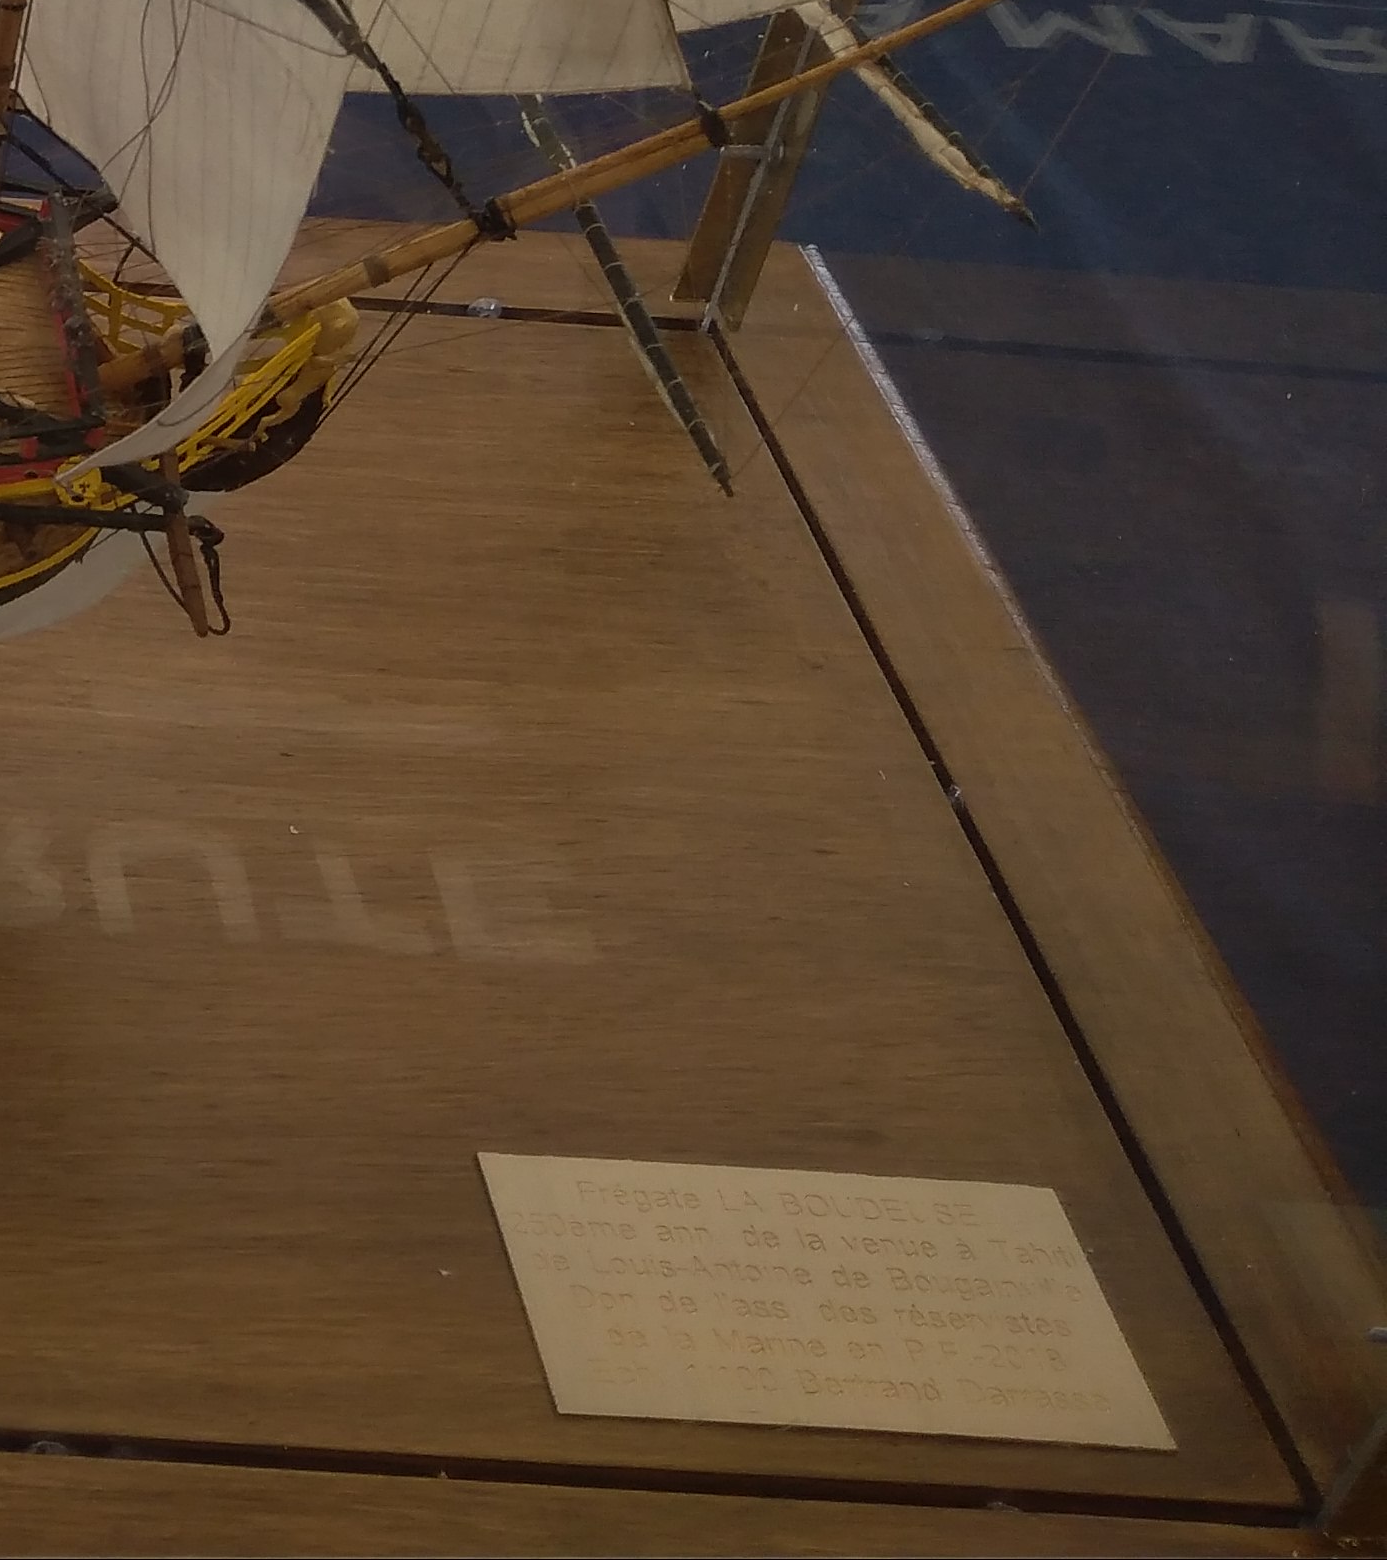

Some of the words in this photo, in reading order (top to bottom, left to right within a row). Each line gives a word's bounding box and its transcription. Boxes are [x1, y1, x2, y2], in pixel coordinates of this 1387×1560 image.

[576, 1179, 701, 1213] Frégate
[717, 1189, 763, 1213] LA
[742, 1224, 779, 1248] de
[797, 1228, 826, 1252] la
[956, 1237, 976, 1261] à
[831, 1265, 871, 1288] de
[659, 1290, 698, 1314] de
[819, 1299, 877, 1325] des
